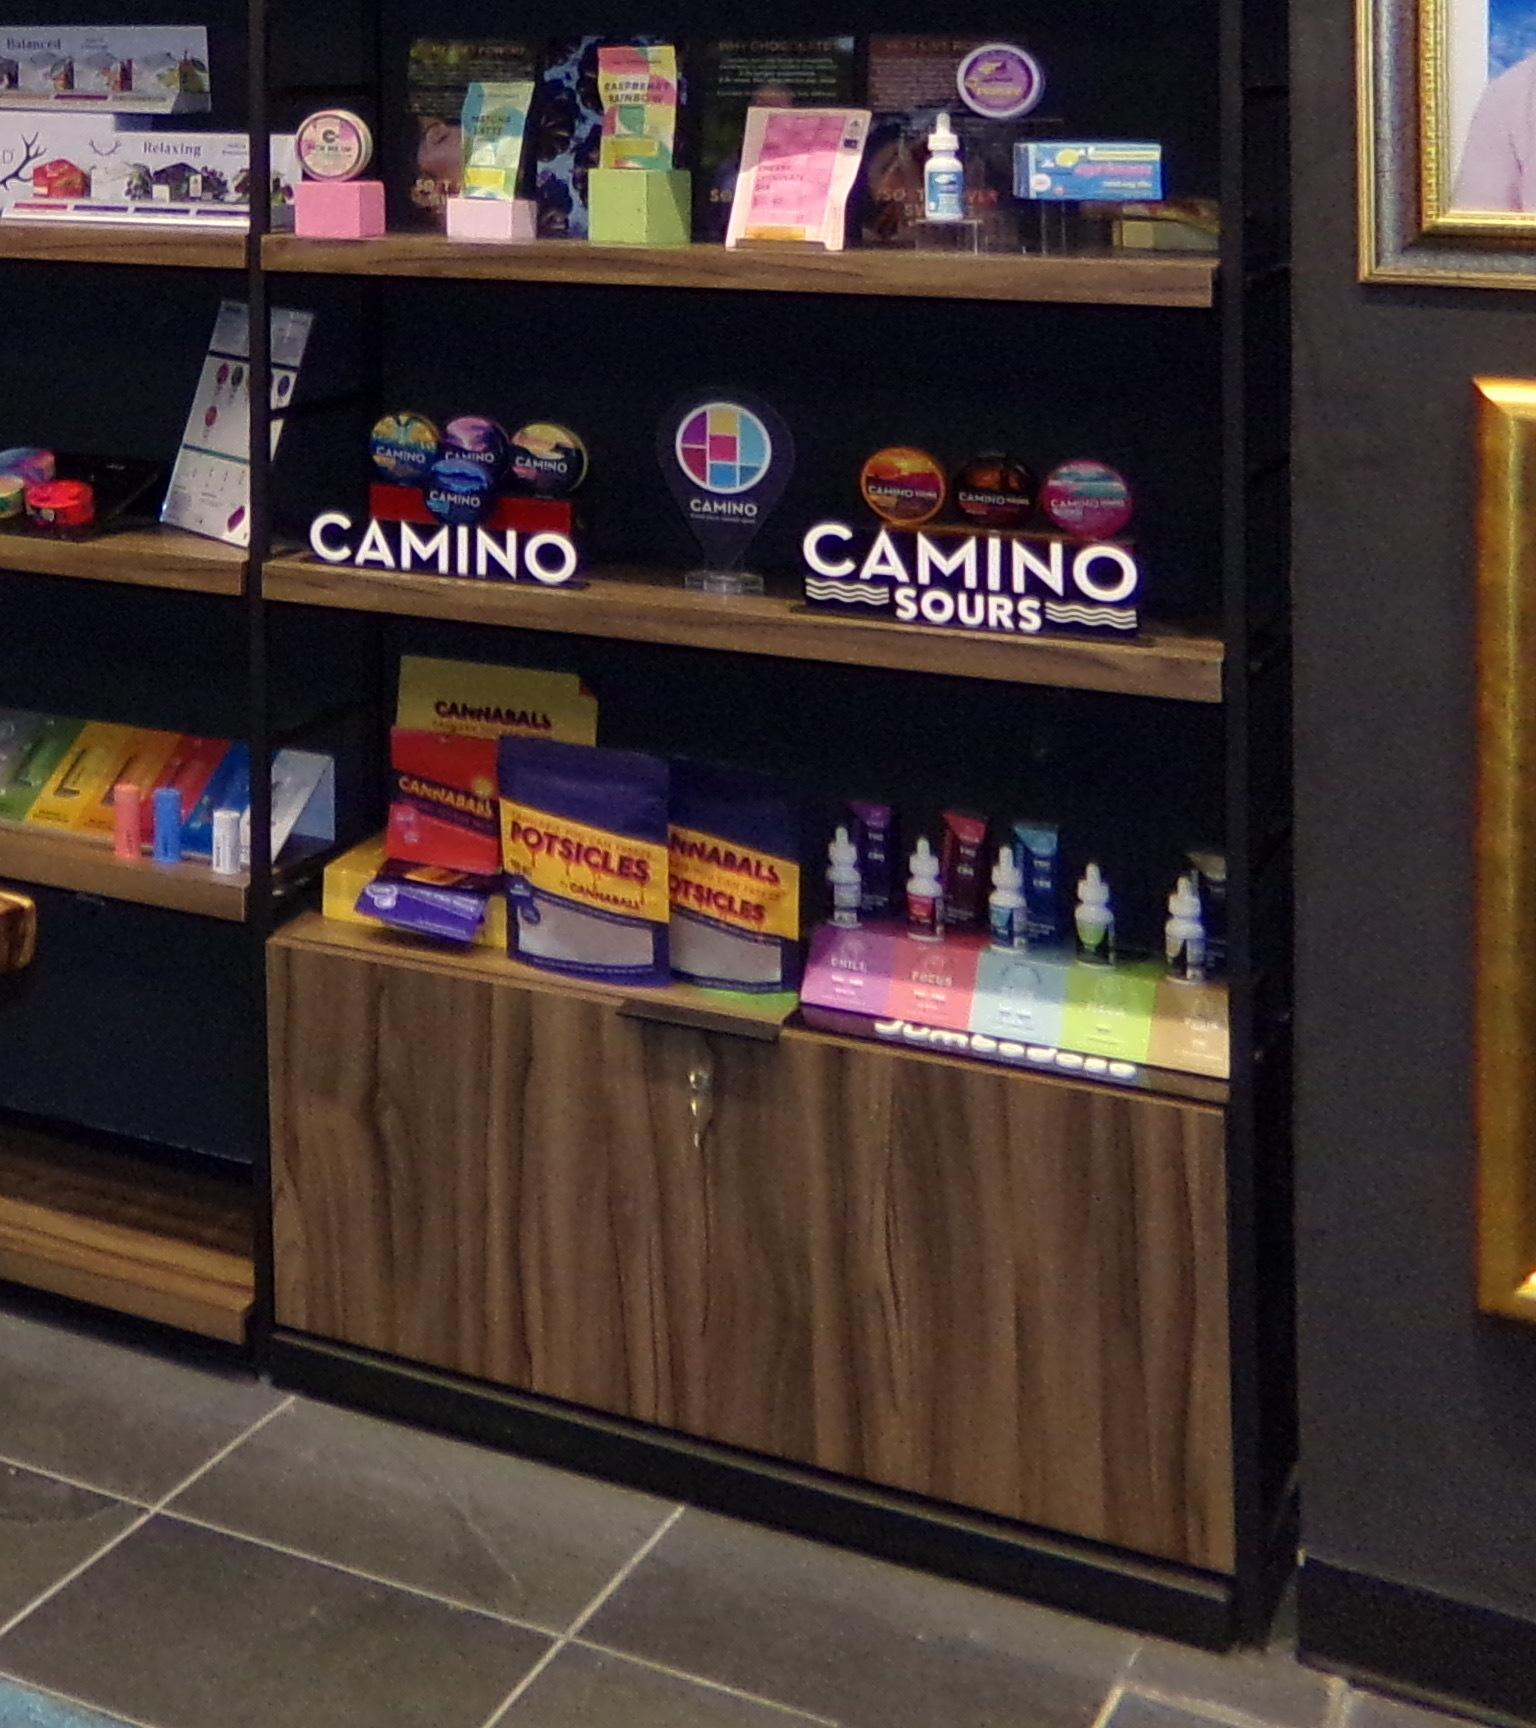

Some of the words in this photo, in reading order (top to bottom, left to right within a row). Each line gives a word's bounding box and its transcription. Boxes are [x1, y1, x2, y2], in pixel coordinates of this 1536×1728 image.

[143, 139, 203, 157] Relaxing
[375, 445, 426, 465] CAMINO
[515, 455, 569, 475] CAMINO
[429, 489, 481, 508] CAMINO
[690, 498, 758, 518] CAMINO
[958, 490, 1005, 506] CAMINO
[310, 512, 578, 584] CAMINO
[803, 522, 1138, 603] CAMINO
[894, 586, 1043, 633] SOURS
[398, 774, 494, 819] CANNABALS
[510, 820, 653, 885] POTSICLES
[669, 828, 783, 886] NNABALS
